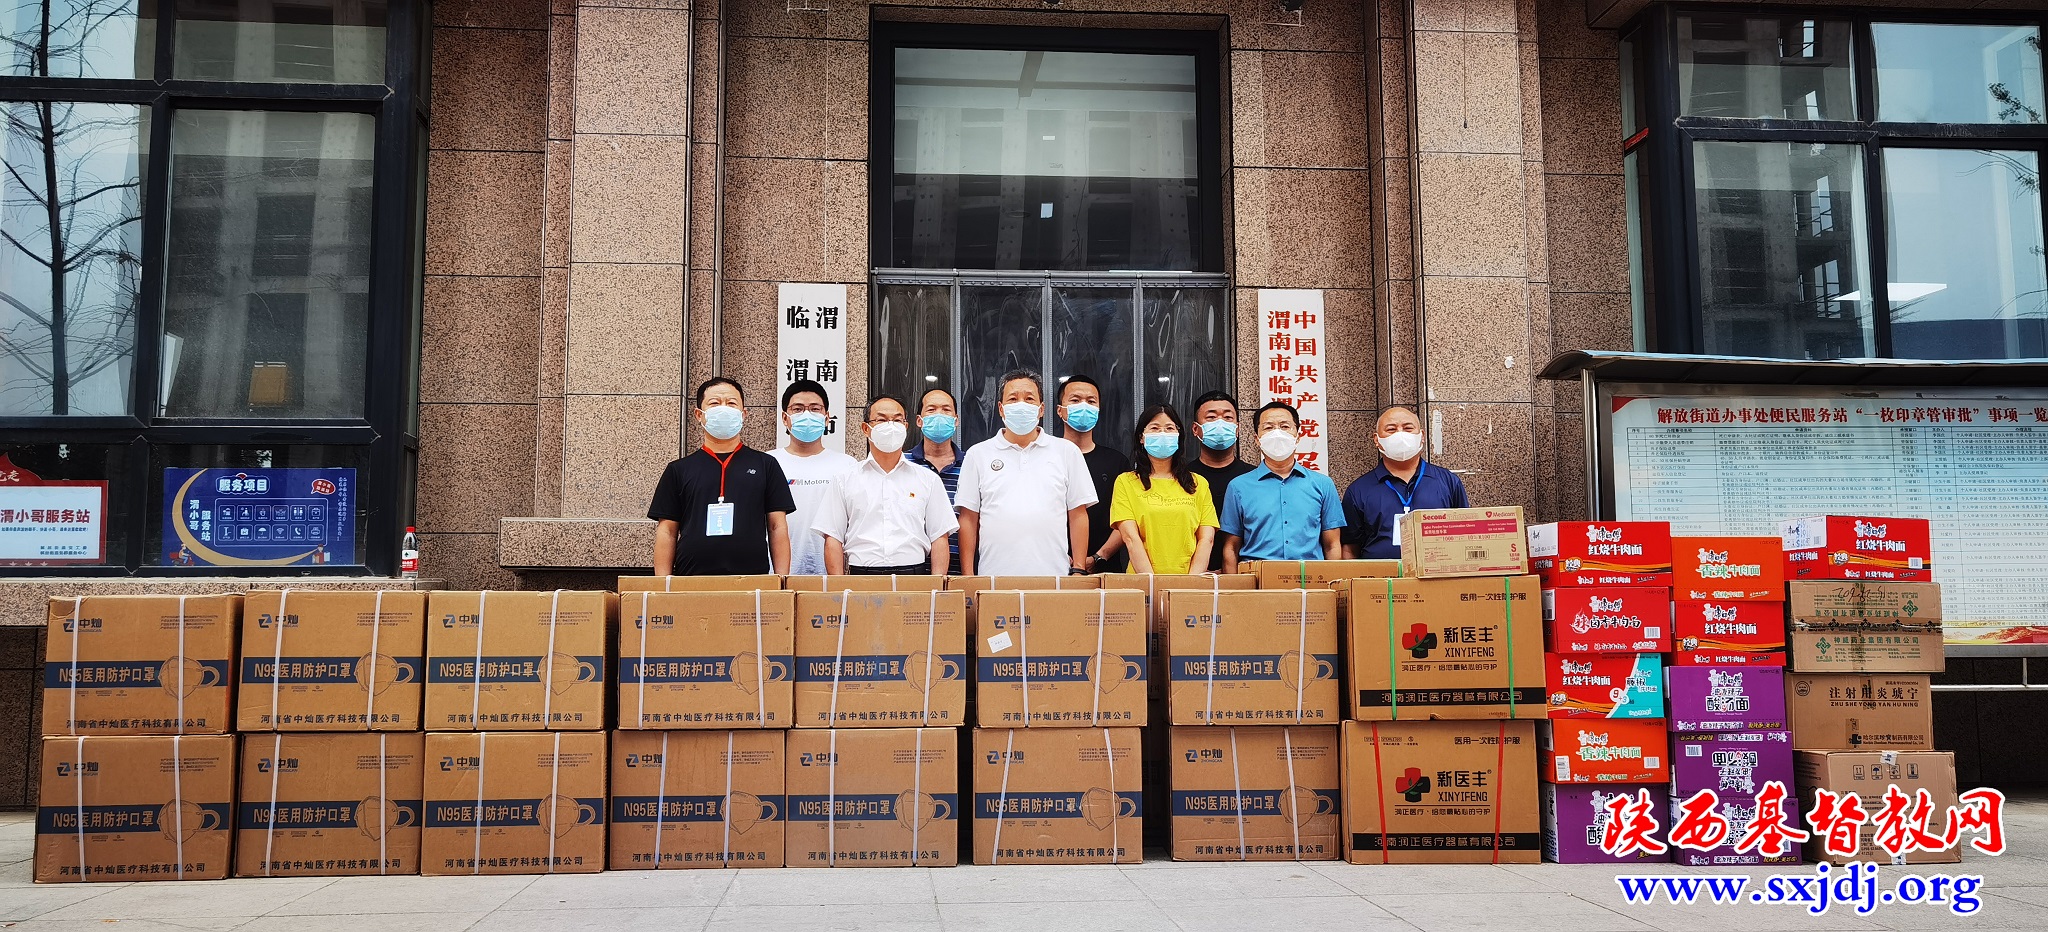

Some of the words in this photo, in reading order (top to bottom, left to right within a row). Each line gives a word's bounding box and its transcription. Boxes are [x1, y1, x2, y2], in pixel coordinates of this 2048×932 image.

[219, 479, 268, 492] 服务项目
[804, 478, 830, 486] Motors
[190, 500, 200, 530] 渭小哥
[201, 510, 212, 541] 服务站
[1511, 543, 1517, 552] S
[1588, 544, 1642, 555] 红烧牛肉面
[1856, 539, 1906, 551] 红烧牛肉面
[1697, 564, 1761, 578] 香辣牛肉面
[1704, 623, 1757, 634] 红烧牛肉面
[1445, 647, 1495, 658] XINYIFENG
[1562, 676, 1611, 685] 红烧牛肉面
[1626, 677, 1646, 686] 藤椒
[1829, 687, 1918, 700] 注射用炎琥宁
[1706, 696, 1749, 711] 酸汤面
[1578, 746, 1641, 761] 香辣牛肉面
[1438, 791, 1488, 802] XINYIFENG
